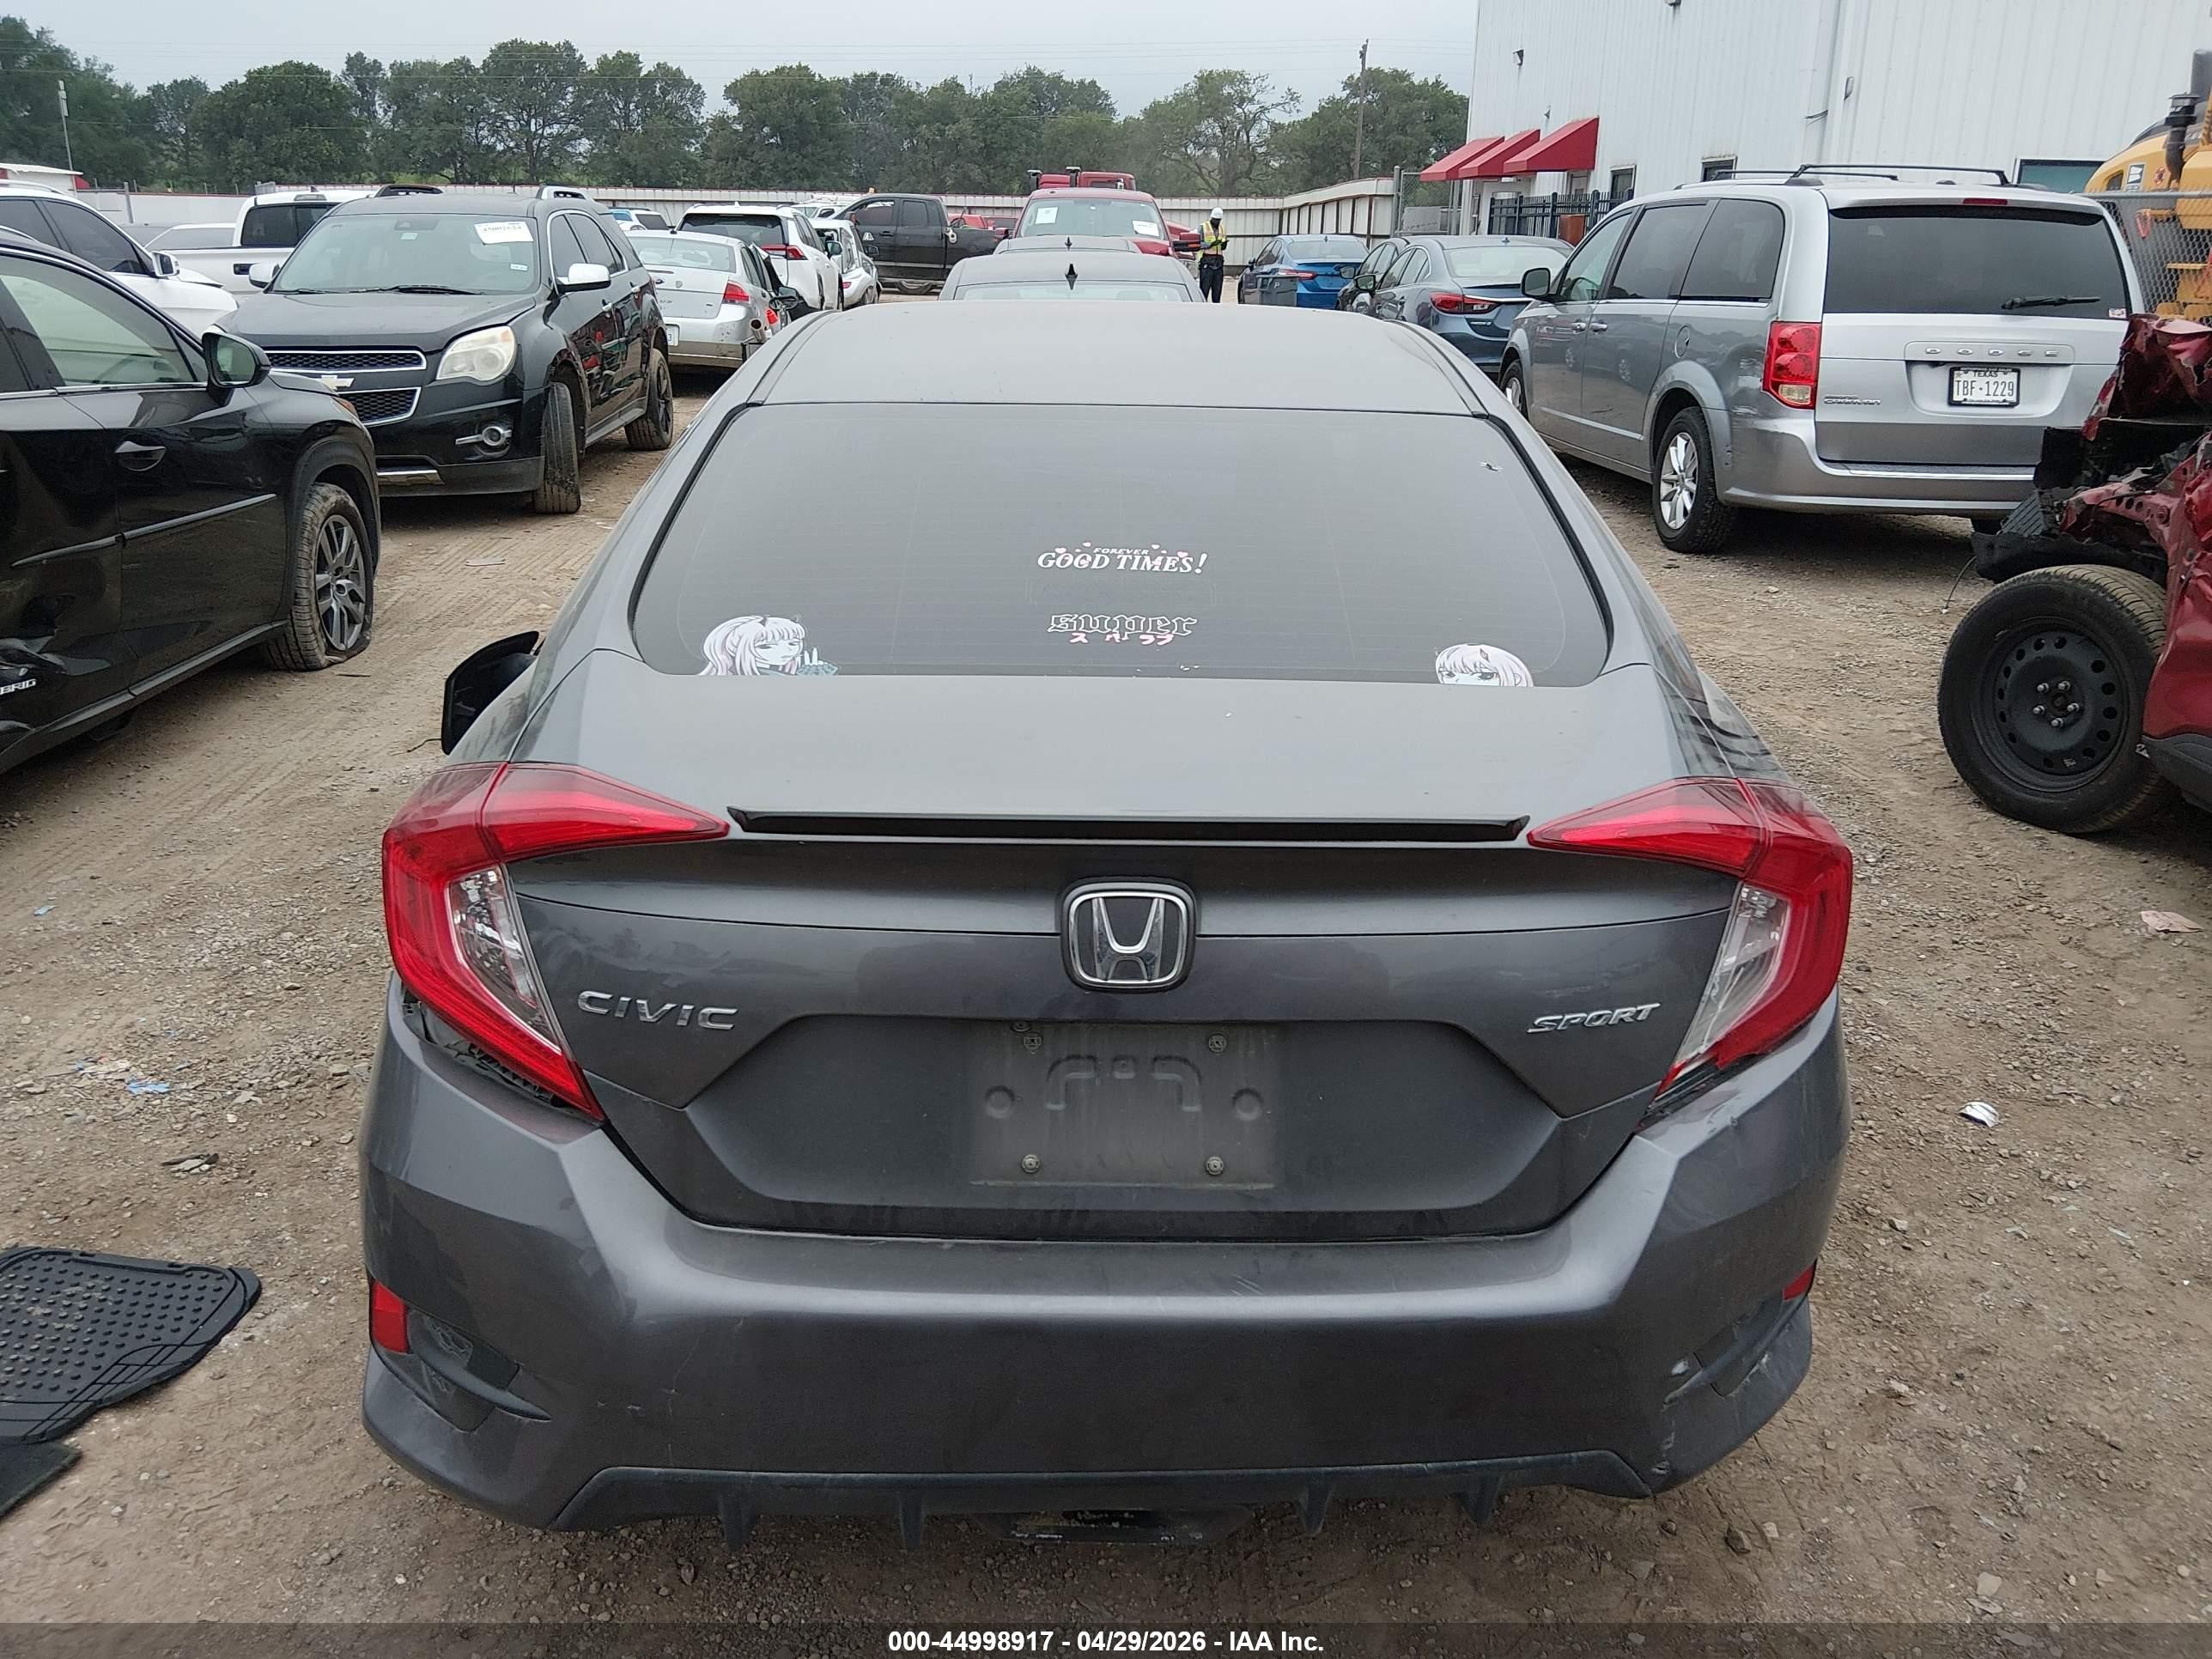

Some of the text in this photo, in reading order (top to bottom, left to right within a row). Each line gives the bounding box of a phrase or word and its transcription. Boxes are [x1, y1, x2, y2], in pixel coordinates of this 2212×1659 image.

[1925, 347, 2058, 357] DODGE
[1037, 552, 1209, 574] GOOD TIMES!
[577, 990, 739, 1030] CIVIC
[1526, 1002, 1662, 1033] SPORT
